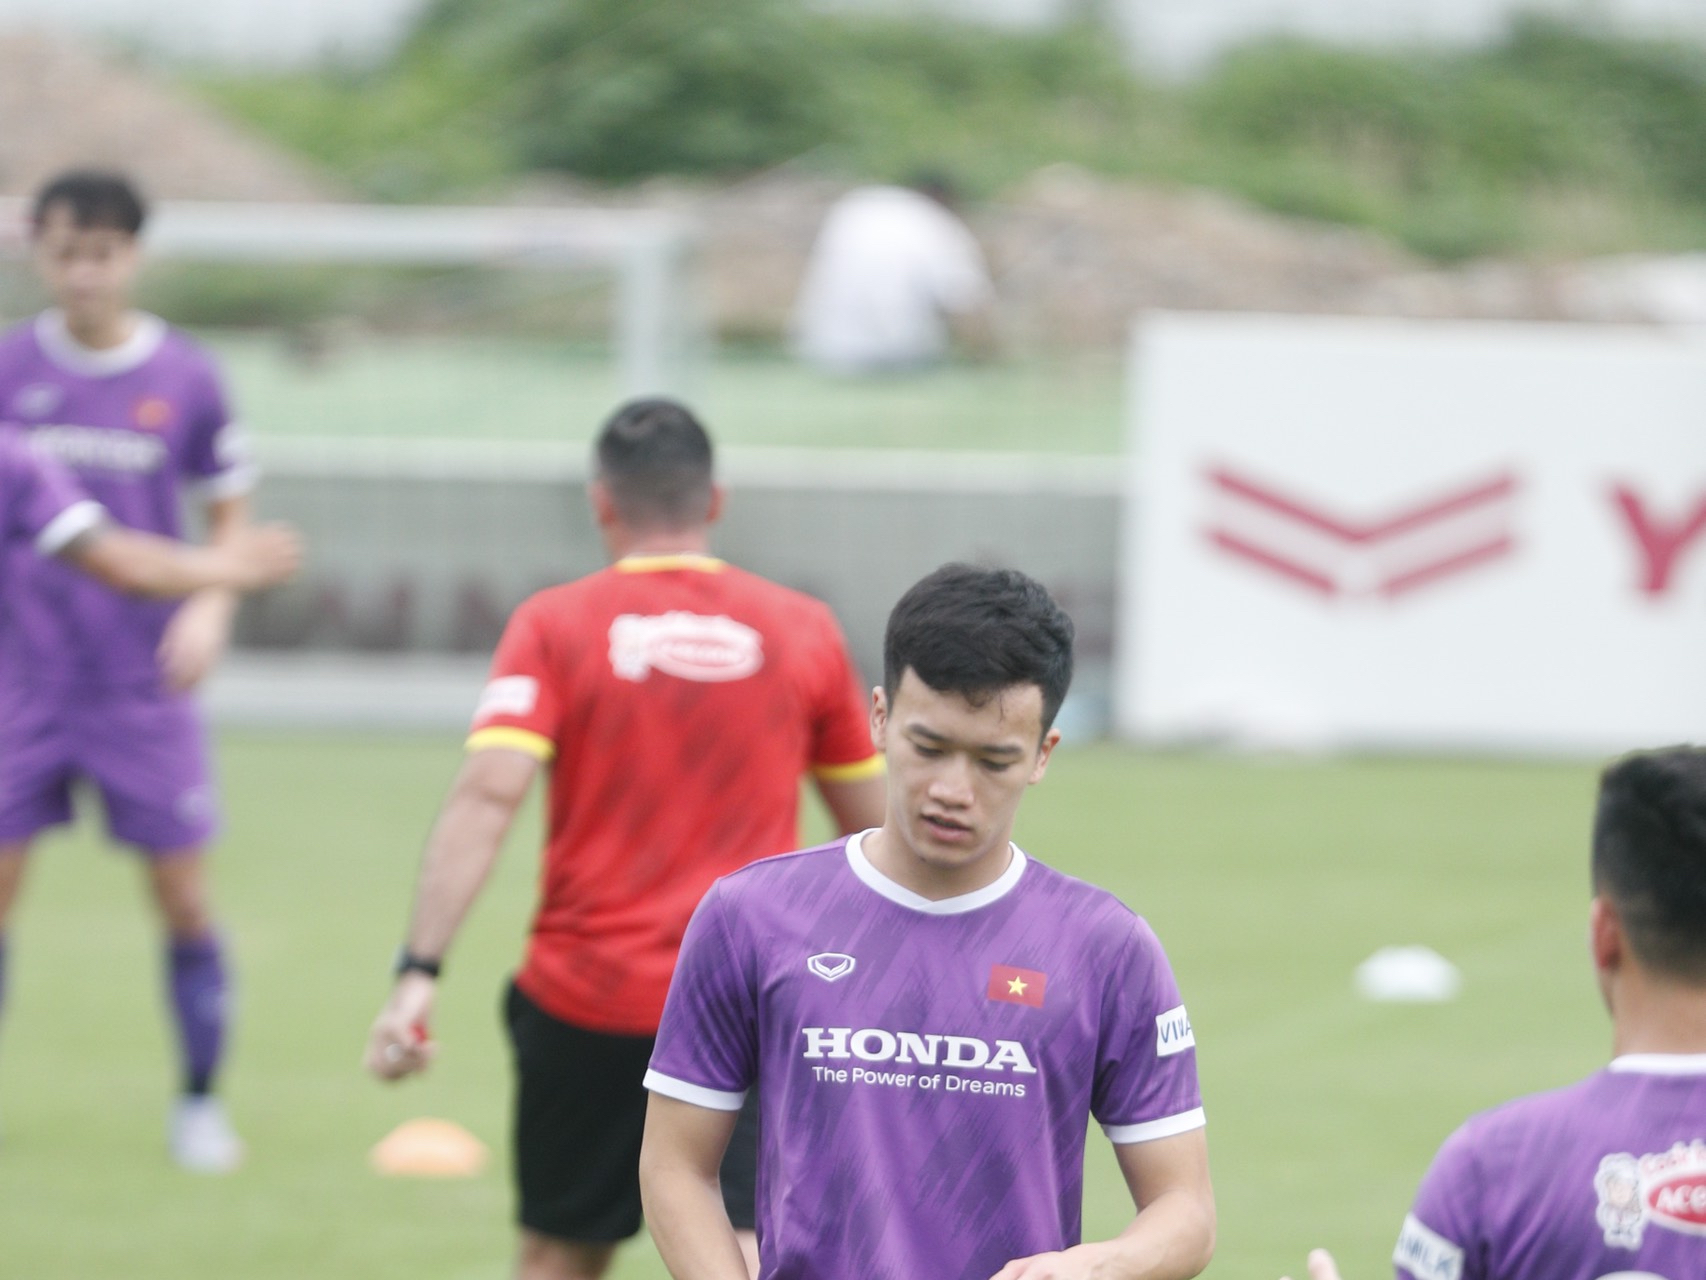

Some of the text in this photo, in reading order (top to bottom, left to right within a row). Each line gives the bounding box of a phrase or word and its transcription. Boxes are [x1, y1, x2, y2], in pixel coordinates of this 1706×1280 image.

[801, 1027, 1037, 1074] HONDA
[811, 1066, 1026, 1098] The Power of Dreams
